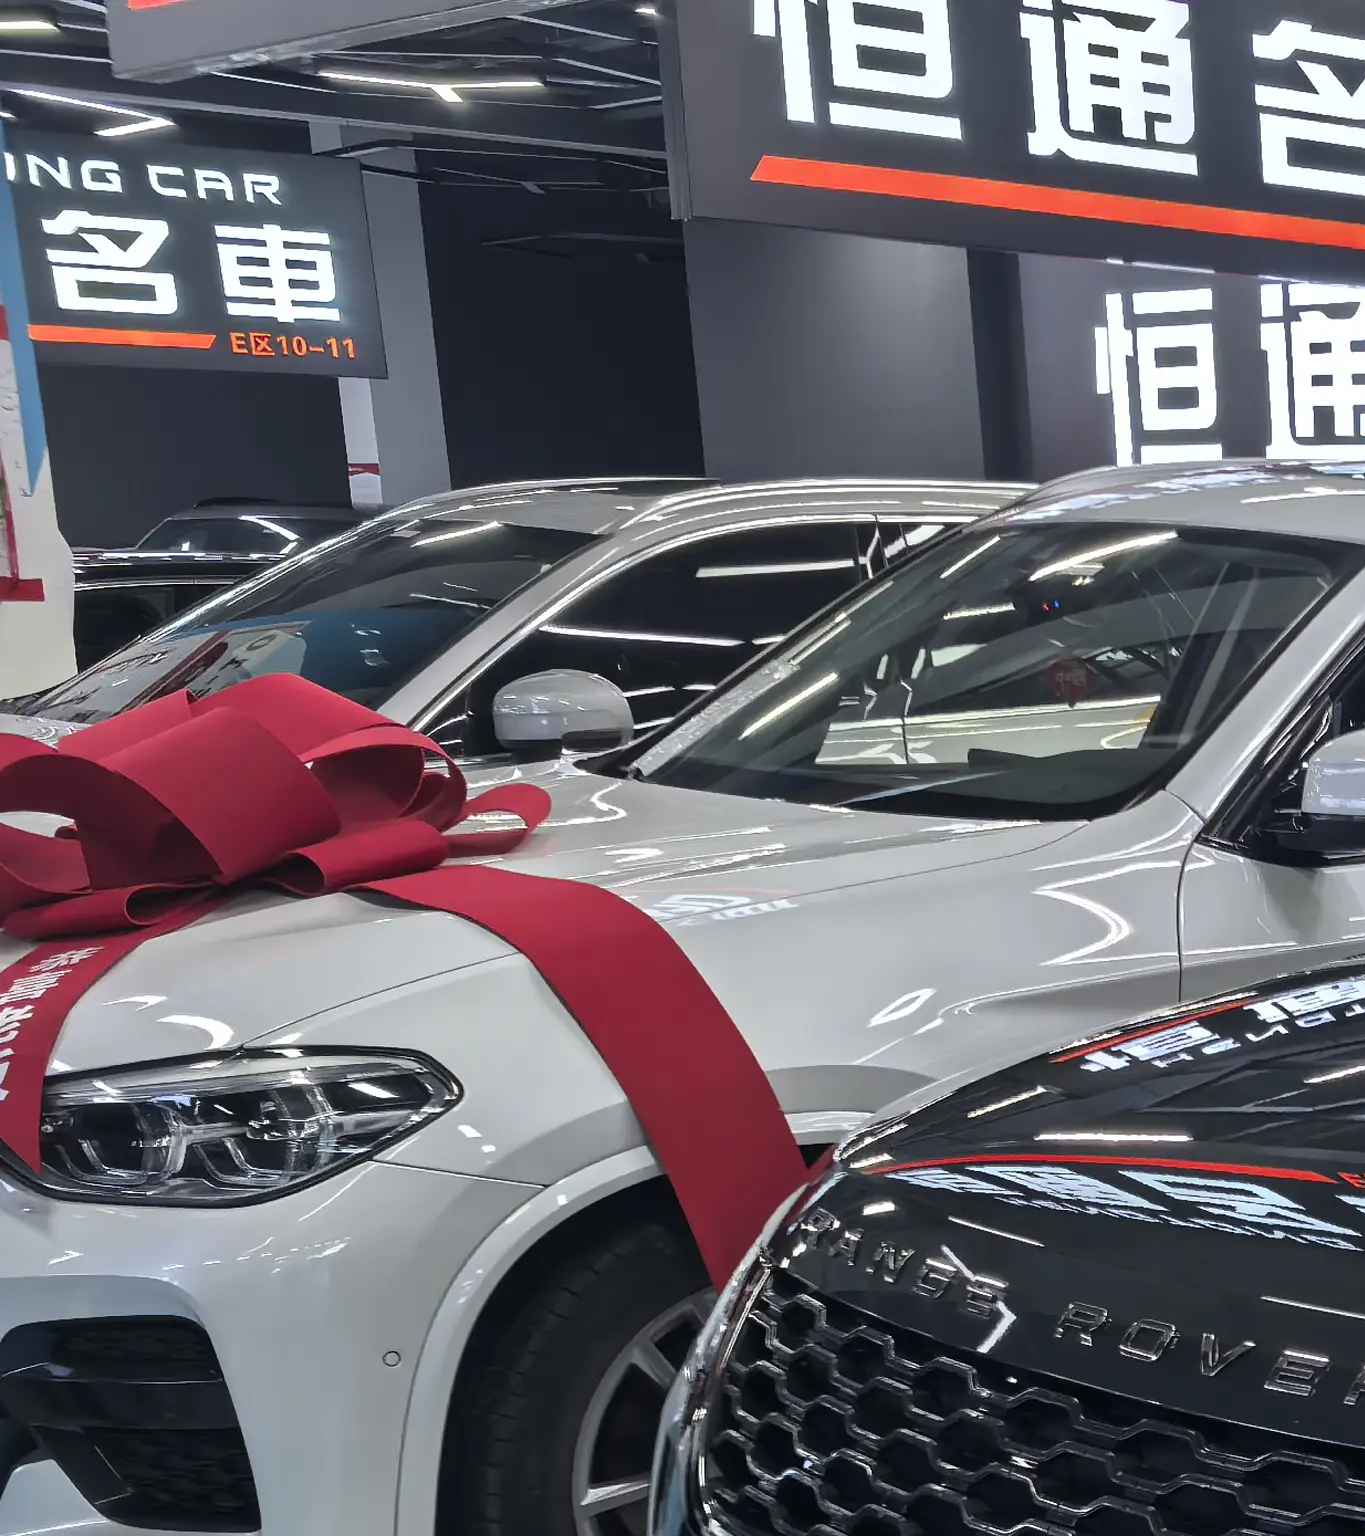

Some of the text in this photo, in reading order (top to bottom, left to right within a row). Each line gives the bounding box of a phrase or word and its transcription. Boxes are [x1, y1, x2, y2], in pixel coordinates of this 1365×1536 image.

[146, 164, 283, 206] CAR
[41, 209, 341, 323] 名車
[229, 331, 356, 359] E区10-11
[793, 1207, 1009, 1319] RANGE
